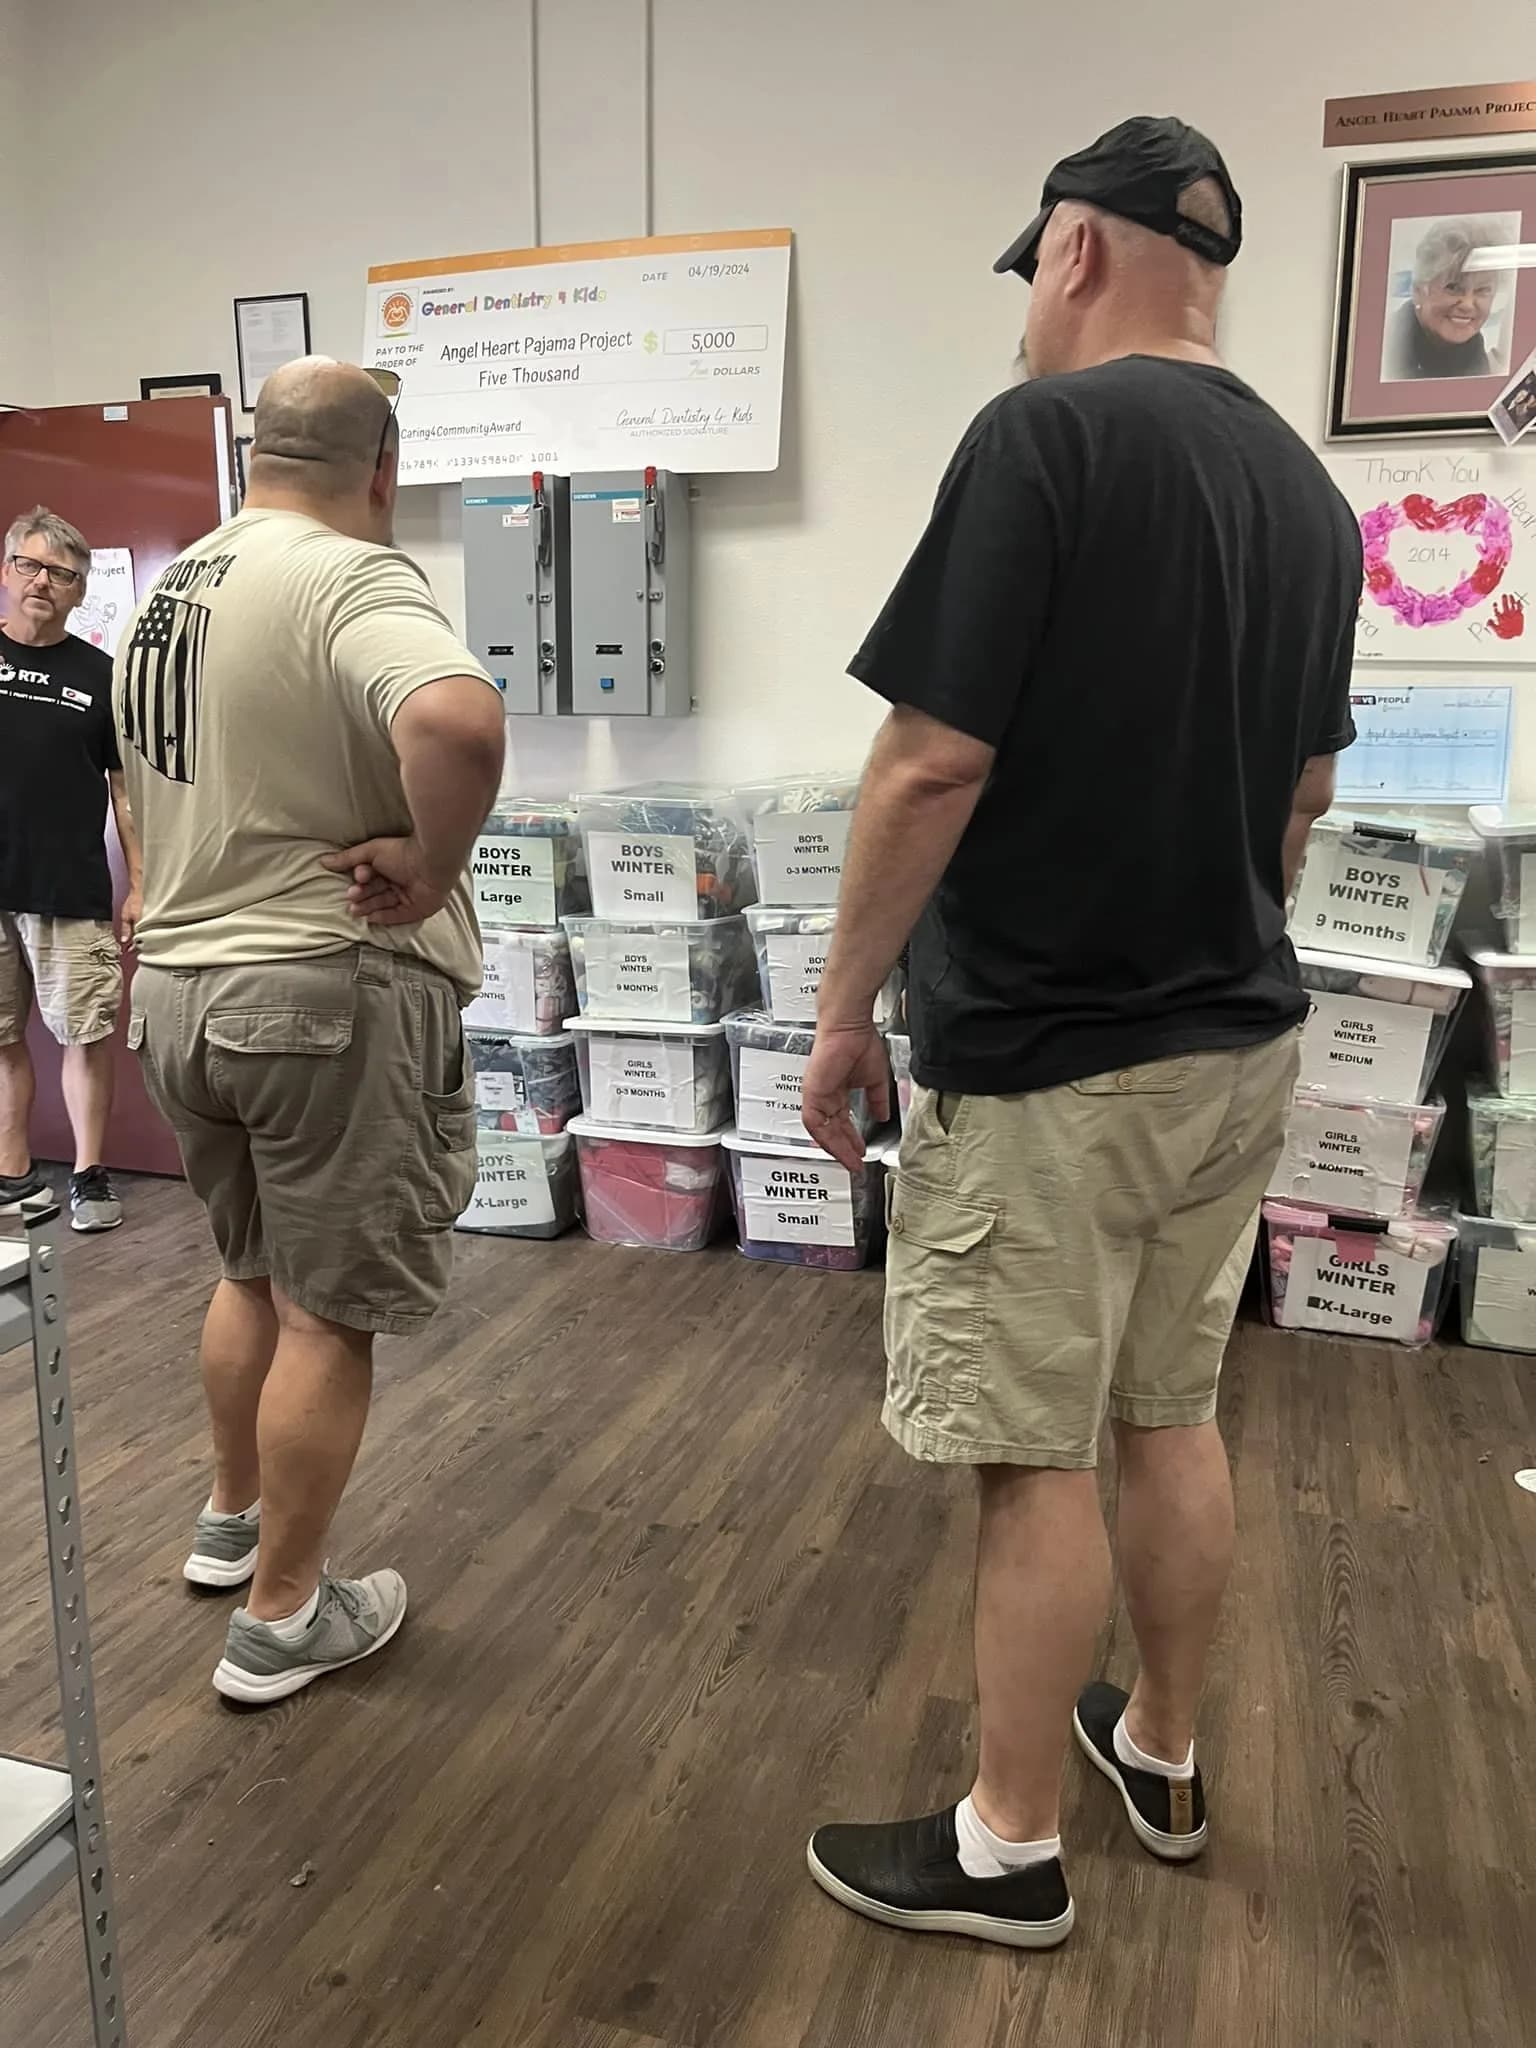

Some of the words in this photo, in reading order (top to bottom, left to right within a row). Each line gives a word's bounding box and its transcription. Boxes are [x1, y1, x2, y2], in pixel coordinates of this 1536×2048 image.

[641, 271, 669, 283] DATE
[688, 263, 750, 279] 04/19/2024
[421, 295, 478, 317] General
[483, 290, 553, 312] Dentistry
[573, 286, 608, 303] Kids
[440, 341, 479, 364] Angel
[481, 339, 521, 358] Heart
[524, 335, 576, 357] Pajama
[579, 331, 633, 352] Project
[691, 331, 736, 353] 5,000
[375, 347, 393, 357] PAY
[395, 345, 407, 355] TO
[408, 343, 424, 353] THE
[375, 359, 405, 368] ORDER
[405, 357, 417, 367] OF
[479, 370, 507, 388] Five
[512, 364, 580, 384] Thousand
[713, 366, 760, 377] DOLLARS
[530, 452, 559, 463] 1001
[1446, 456, 1480, 483] You
[1407, 547, 1452, 563] 2014
[18, 669, 50, 686] RTX
[798, 834, 823, 844] BOYS
[479, 847, 521, 861] BOYS
[621, 844, 664, 858] BOYS
[793, 845, 830, 854] WINTER
[611, 861, 675, 875] WINTER
[786, 867, 800, 875] 0-3
[801, 866, 841, 875] MONTHS
[1345, 867, 1401, 889] BOYS
[480, 890, 522, 906] Large
[623, 889, 665, 903] Small
[1328, 883, 1410, 911] WINTER
[1315, 913, 1327, 927] 9
[1332, 916, 1407, 943] months
[624, 955, 648, 964] BOYS
[809, 956, 828, 965] BOY
[620, 964, 653, 973] WINTER
[623, 983, 659, 993] MONTHS
[480, 991, 506, 1001] ONTHS
[1340, 1019, 1374, 1032] GIRLS
[1333, 1029, 1377, 1044] WINTER
[627, 1059, 653, 1069] GIRLS
[1329, 1050, 1374, 1066] MEDIUM
[623, 1069, 657, 1079] WINTER
[630, 1088, 666, 1099] MONTHS
[775, 1082, 804, 1094] WINTE
[1325, 1131, 1358, 1143] GIRLS
[1318, 1140, 1361, 1154] WINTER
[1318, 1162, 1364, 1177] MONTHS
[771, 1170, 820, 1184] GIRLS
[764, 1185, 830, 1201] WINTER
[474, 1196, 529, 1209] X-Large
[777, 1212, 819, 1226] Small
[1316, 1268, 1396, 1296] WINTER
[1320, 1298, 1393, 1326] X-Large
